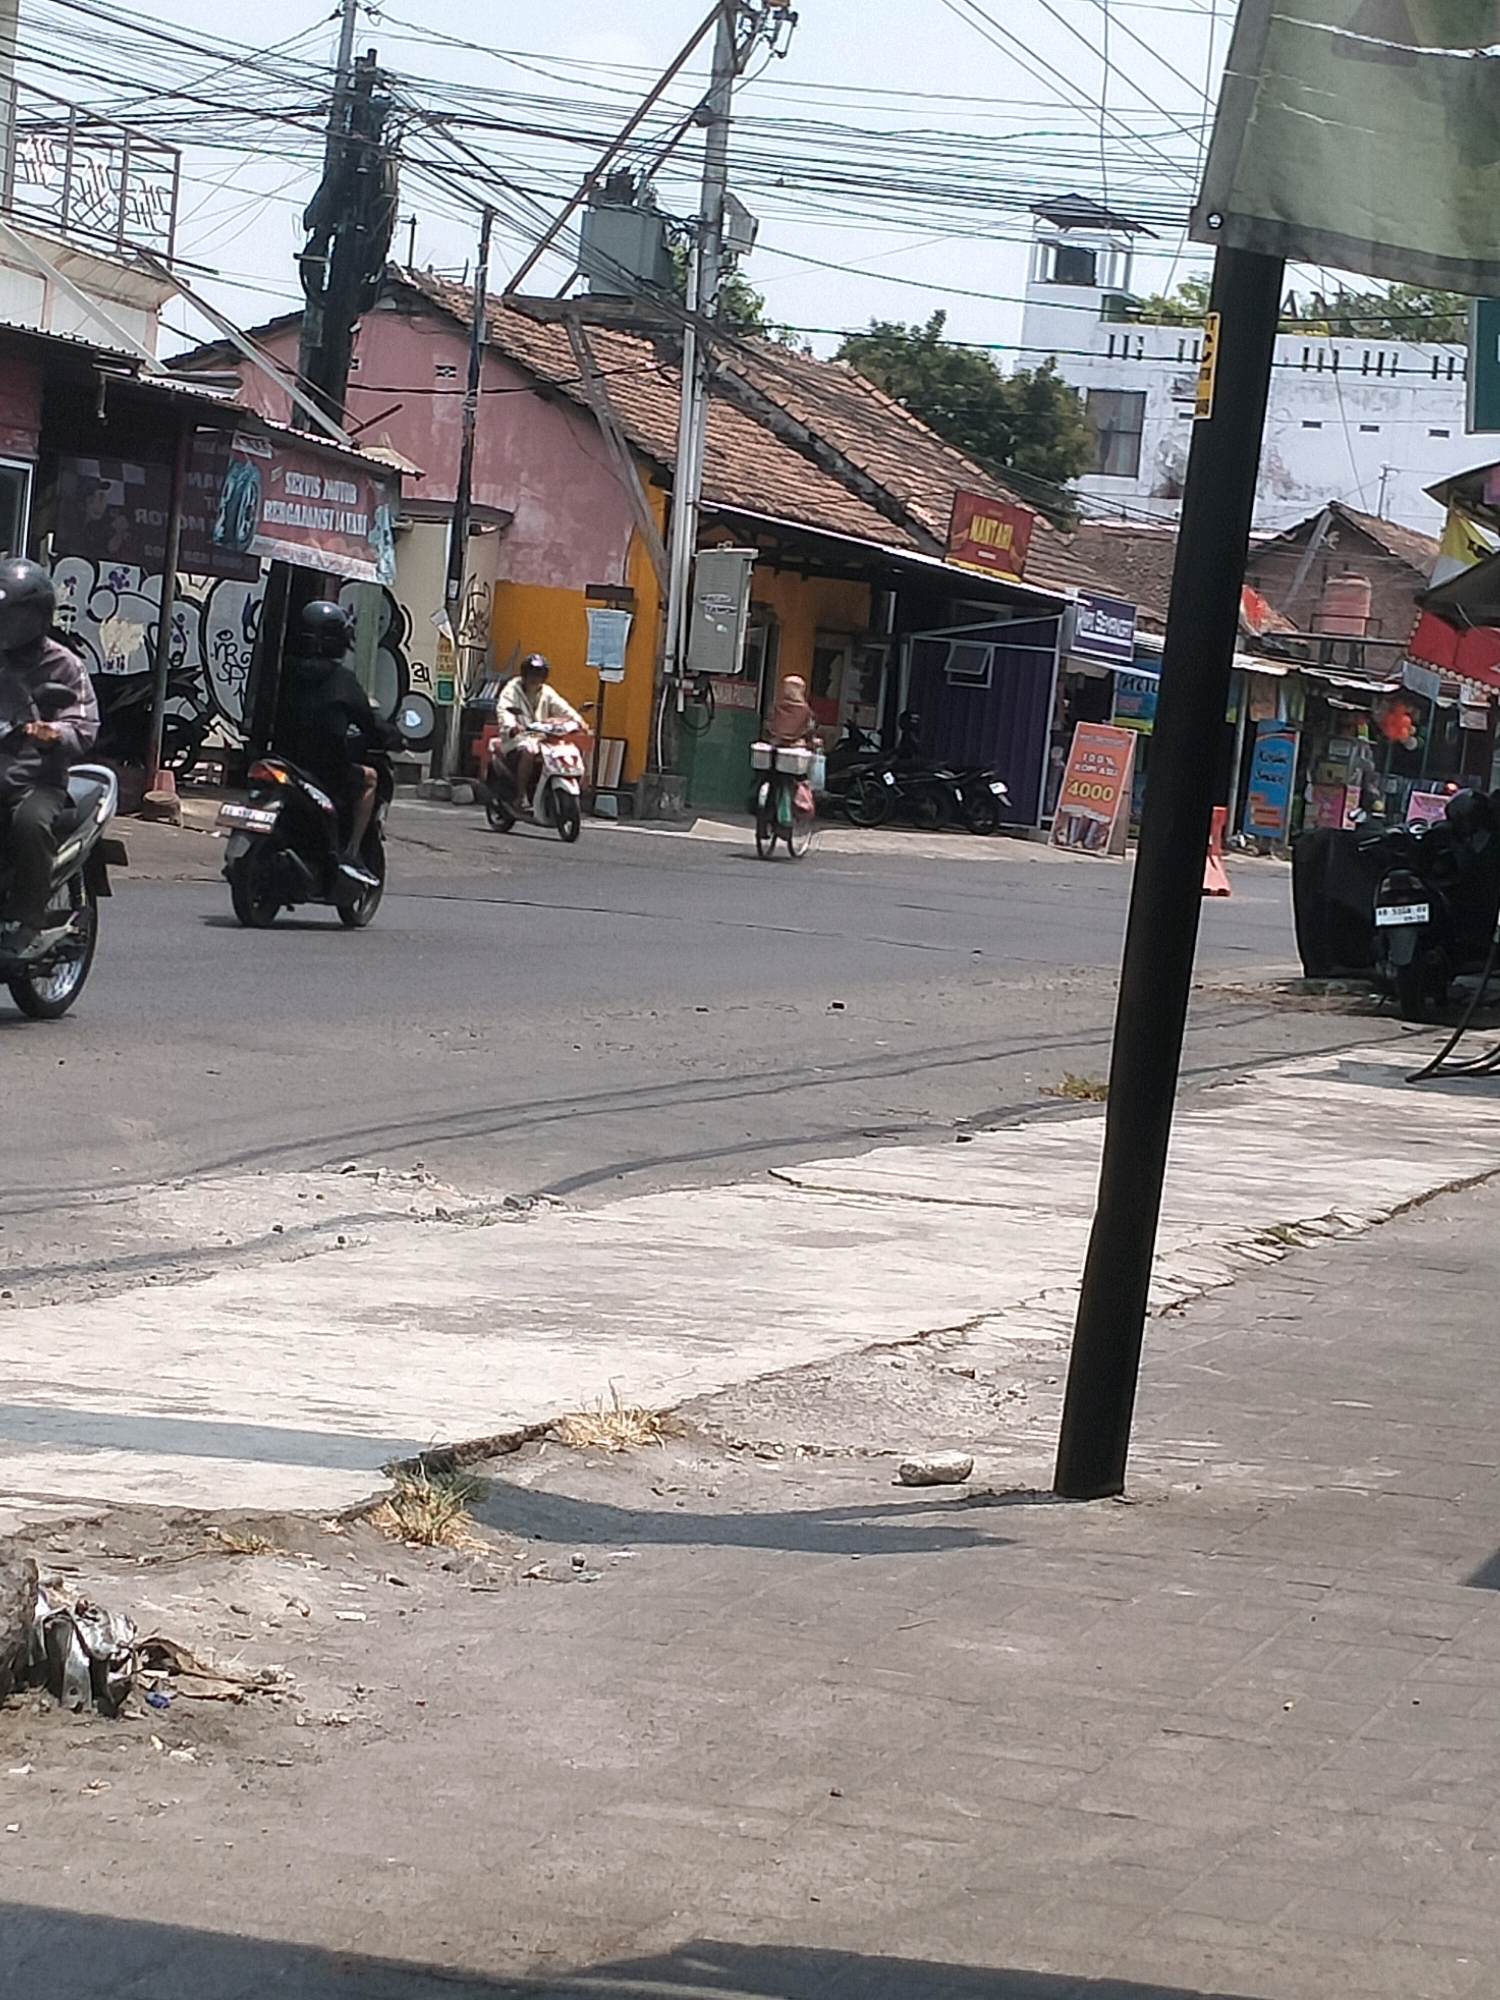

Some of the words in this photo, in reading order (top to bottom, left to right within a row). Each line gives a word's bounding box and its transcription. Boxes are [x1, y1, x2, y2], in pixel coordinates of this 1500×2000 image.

[285, 471, 321, 498] SERVIS
[322, 478, 358, 504] MOTOR
[1082, 753, 1115, 765] 100%
[1067, 781, 1114, 801] 4000
